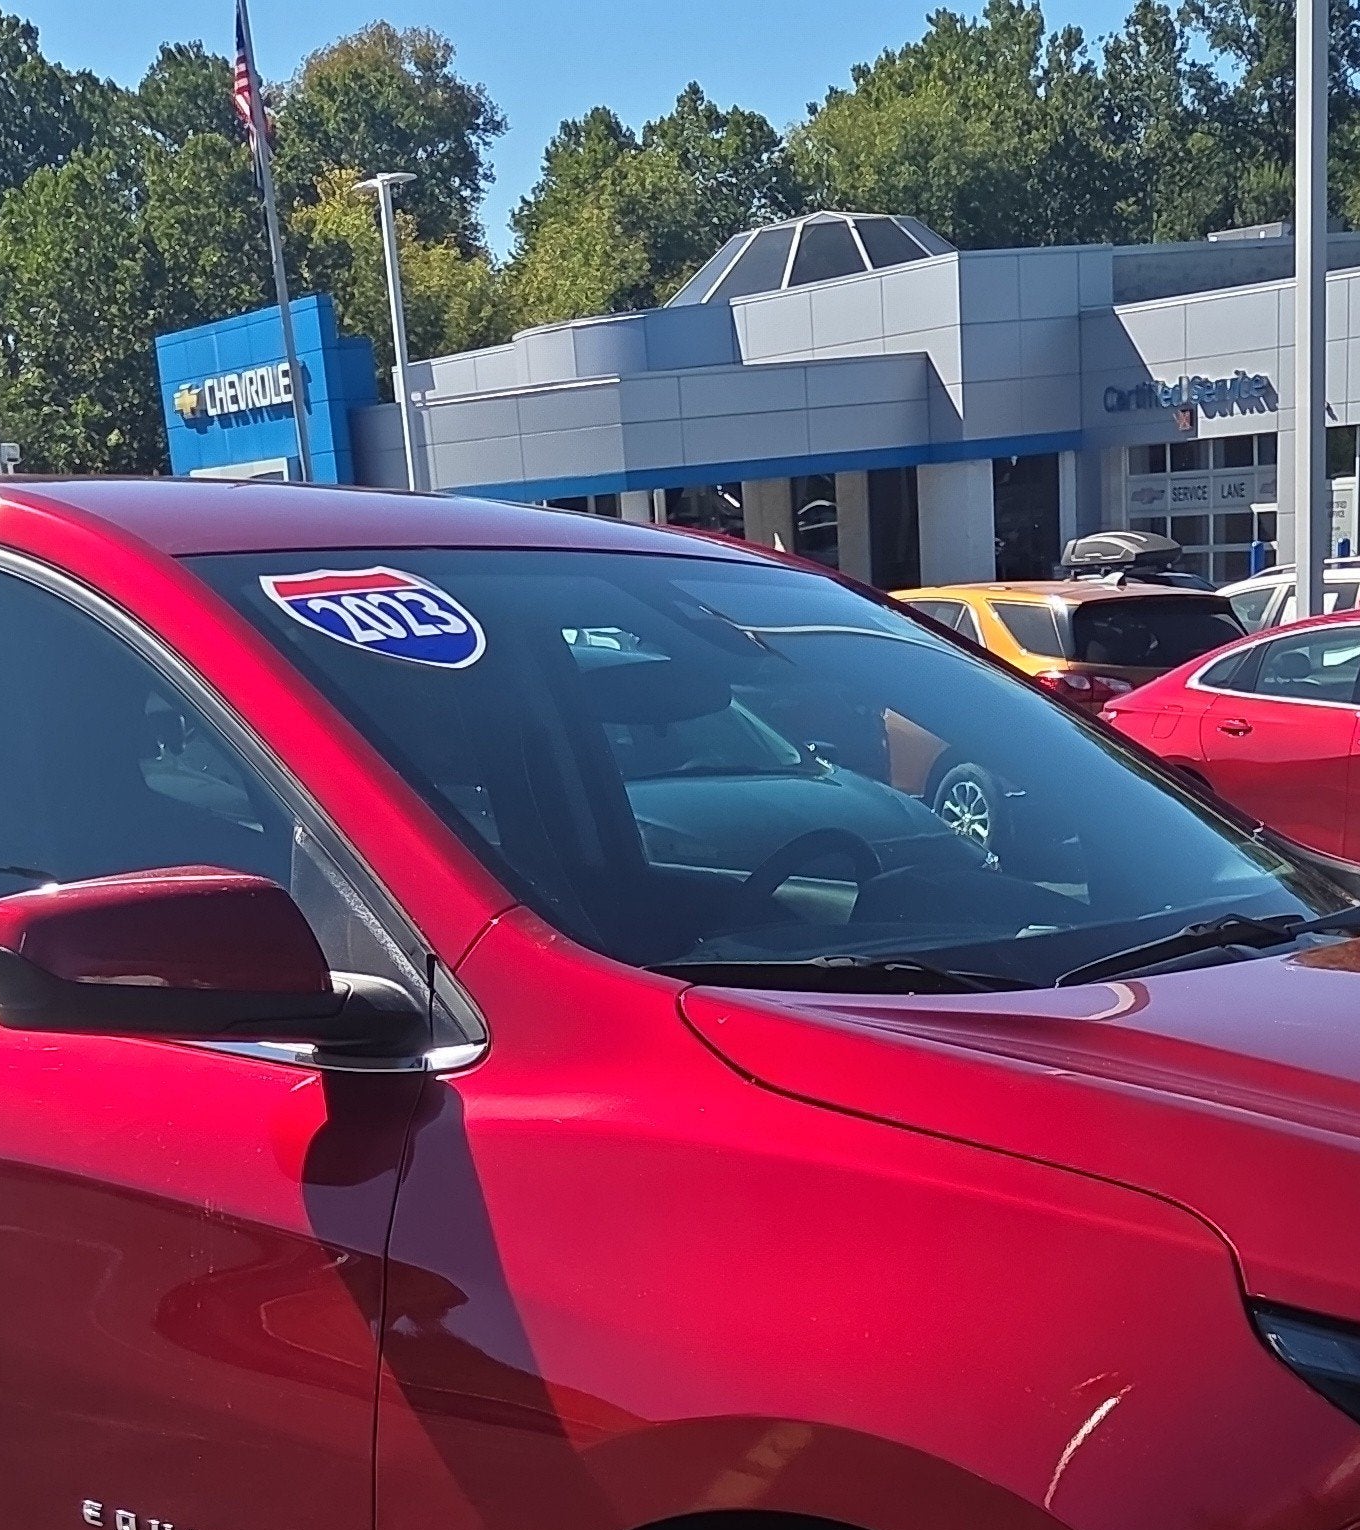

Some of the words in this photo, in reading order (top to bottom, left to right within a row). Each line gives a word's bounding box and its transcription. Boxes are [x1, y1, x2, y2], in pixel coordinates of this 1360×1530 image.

[204, 362, 295, 417] CHEVROLE
[1190, 371, 1268, 406] Service
[1172, 485, 1208, 502] SERVICE
[1221, 482, 1245, 499] LANE
[307, 591, 468, 643] 2023
